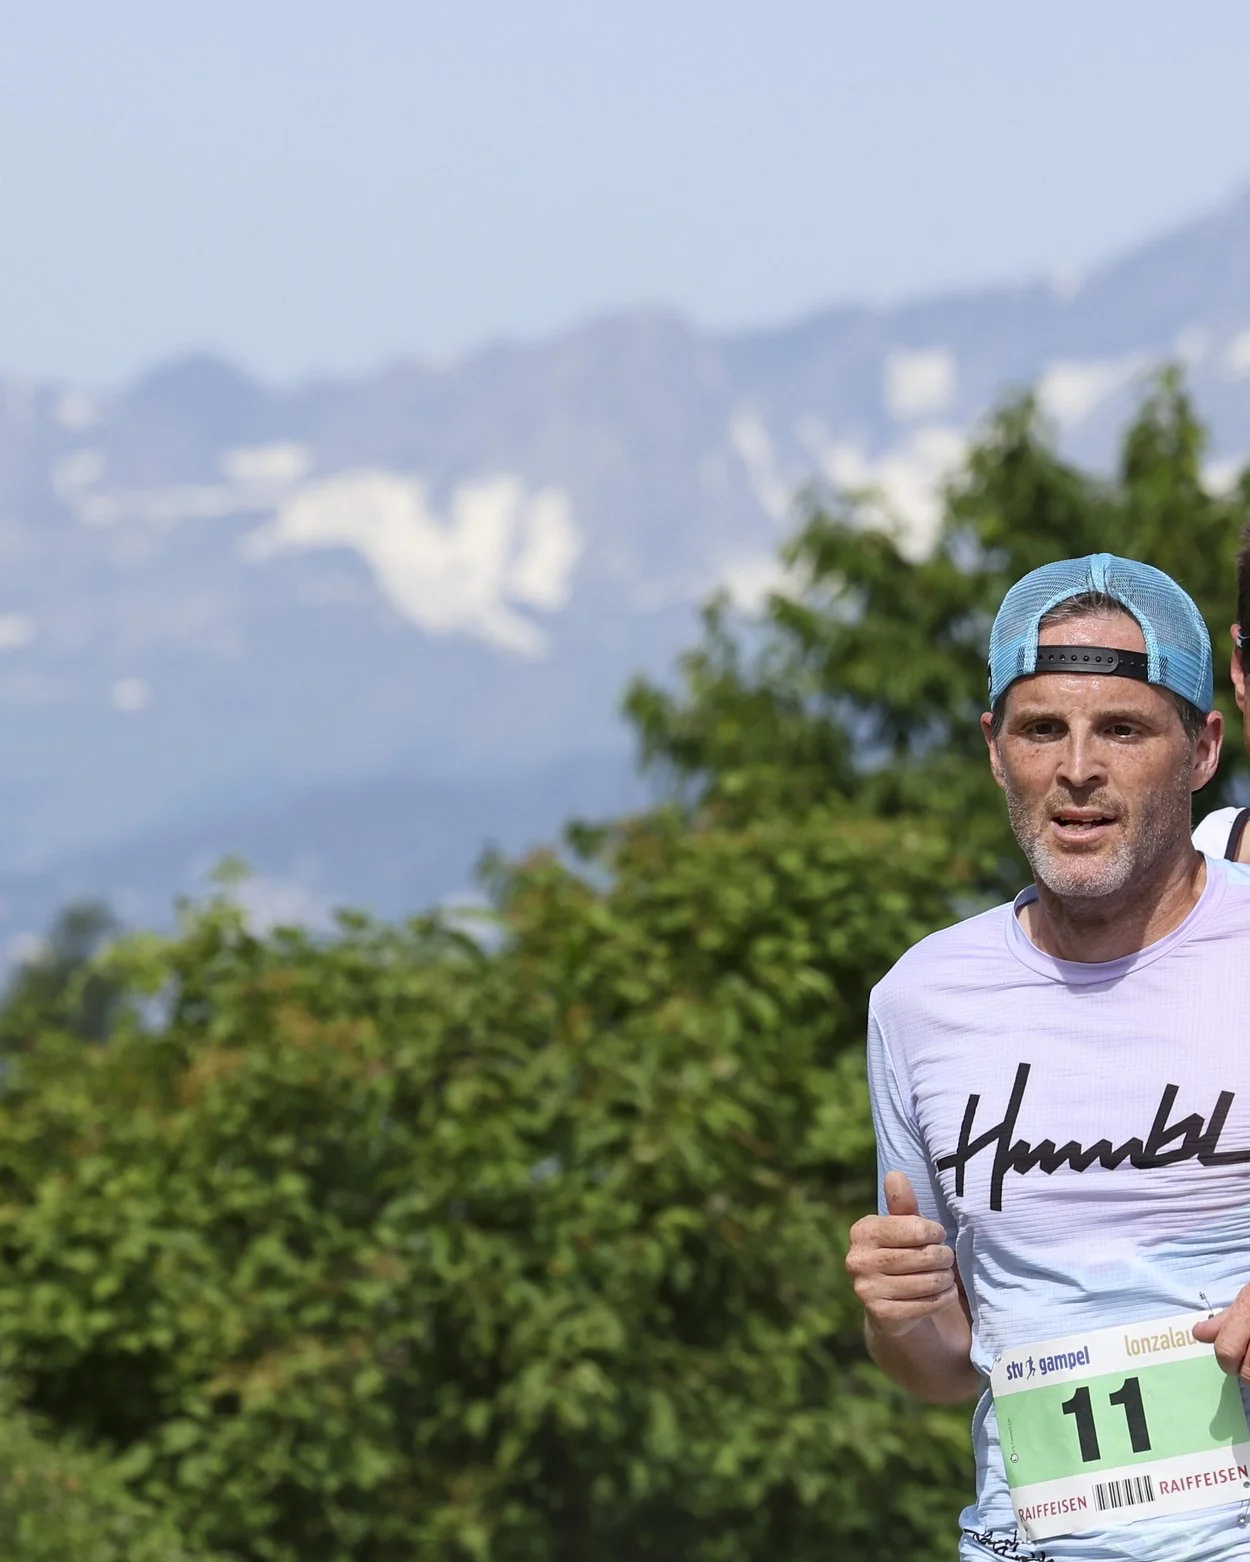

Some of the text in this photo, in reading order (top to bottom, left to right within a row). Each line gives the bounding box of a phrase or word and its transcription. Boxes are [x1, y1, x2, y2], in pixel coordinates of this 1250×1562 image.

[1006, 1345, 1090, 1380] stv gampel
[1124, 1326, 1197, 1356] lonzalau
[1061, 1377, 1152, 1463] 11
[1018, 1464, 1249, 1522] RAIFFEISEN RAIFFEISEN
